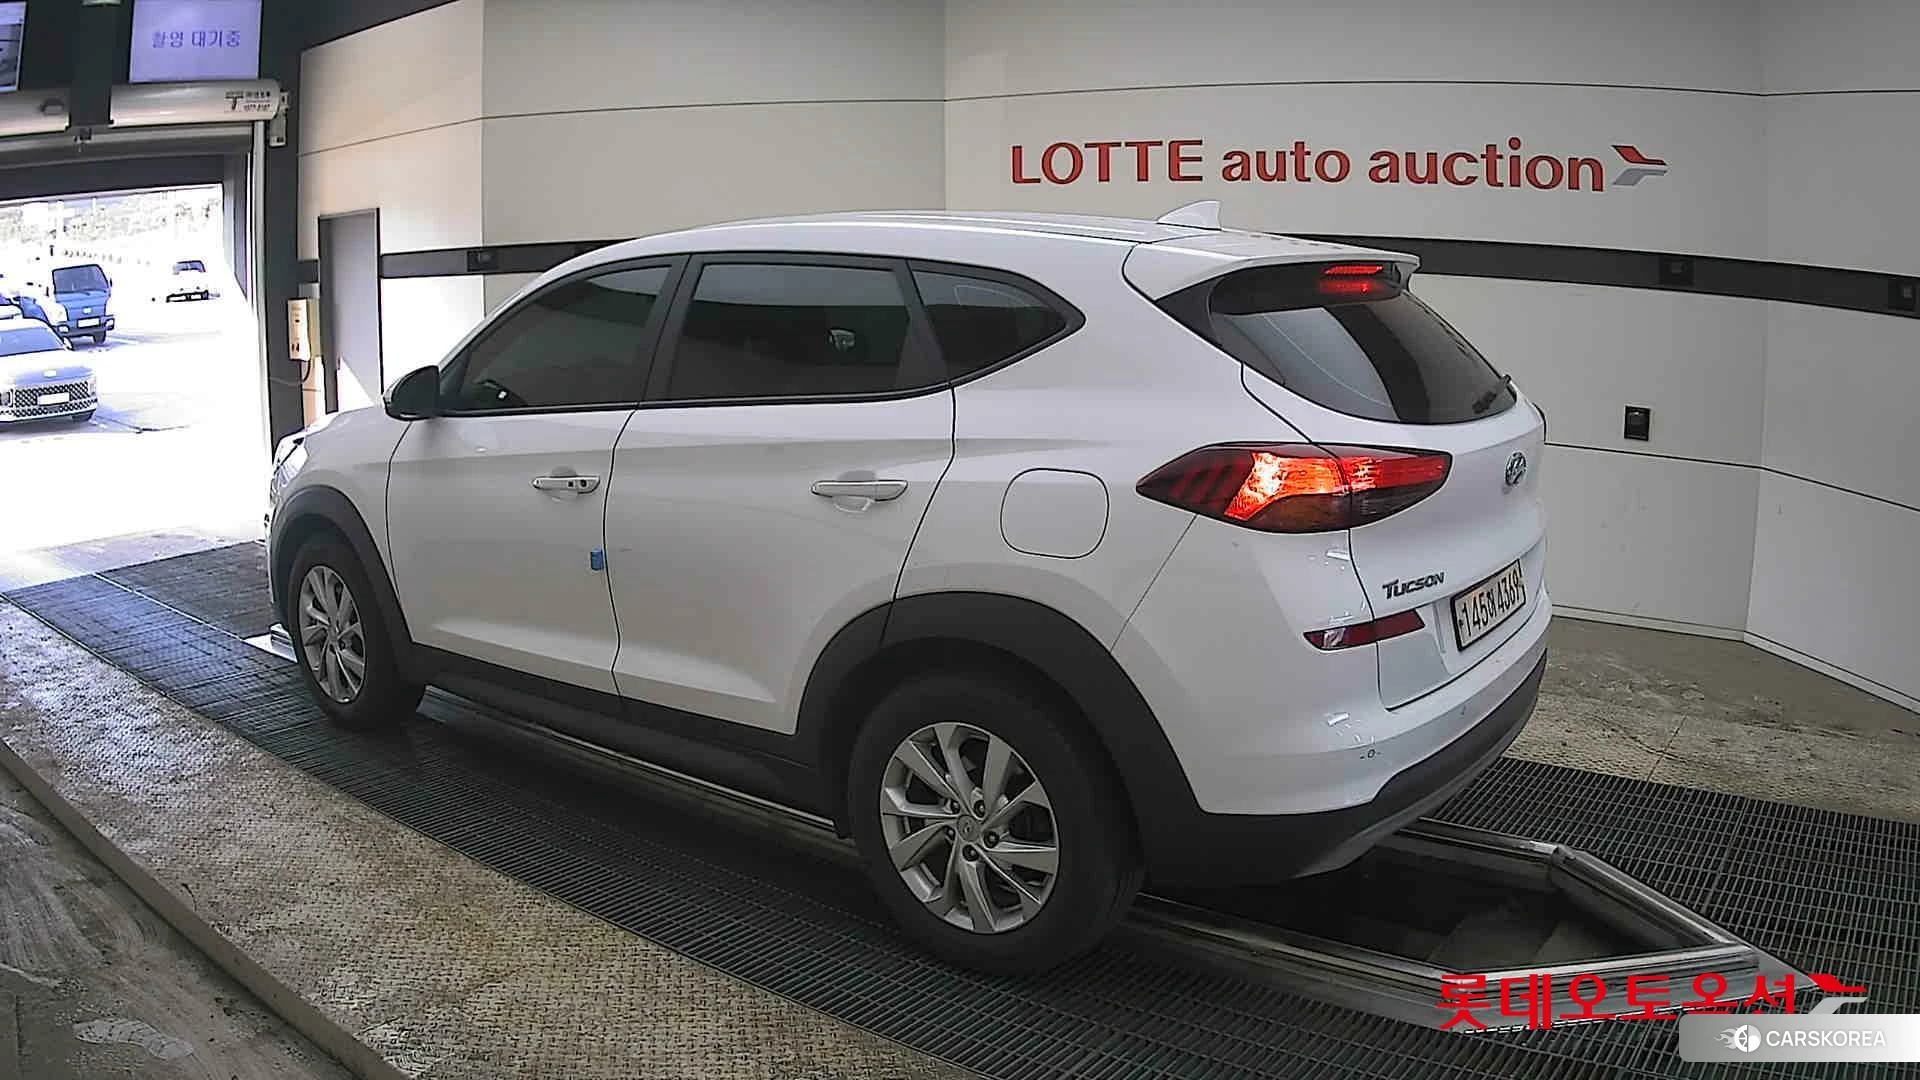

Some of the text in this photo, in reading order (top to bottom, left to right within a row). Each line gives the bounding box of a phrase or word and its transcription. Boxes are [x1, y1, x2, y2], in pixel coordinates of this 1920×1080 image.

[1011, 137, 1604, 192] LOTTE auto auction
